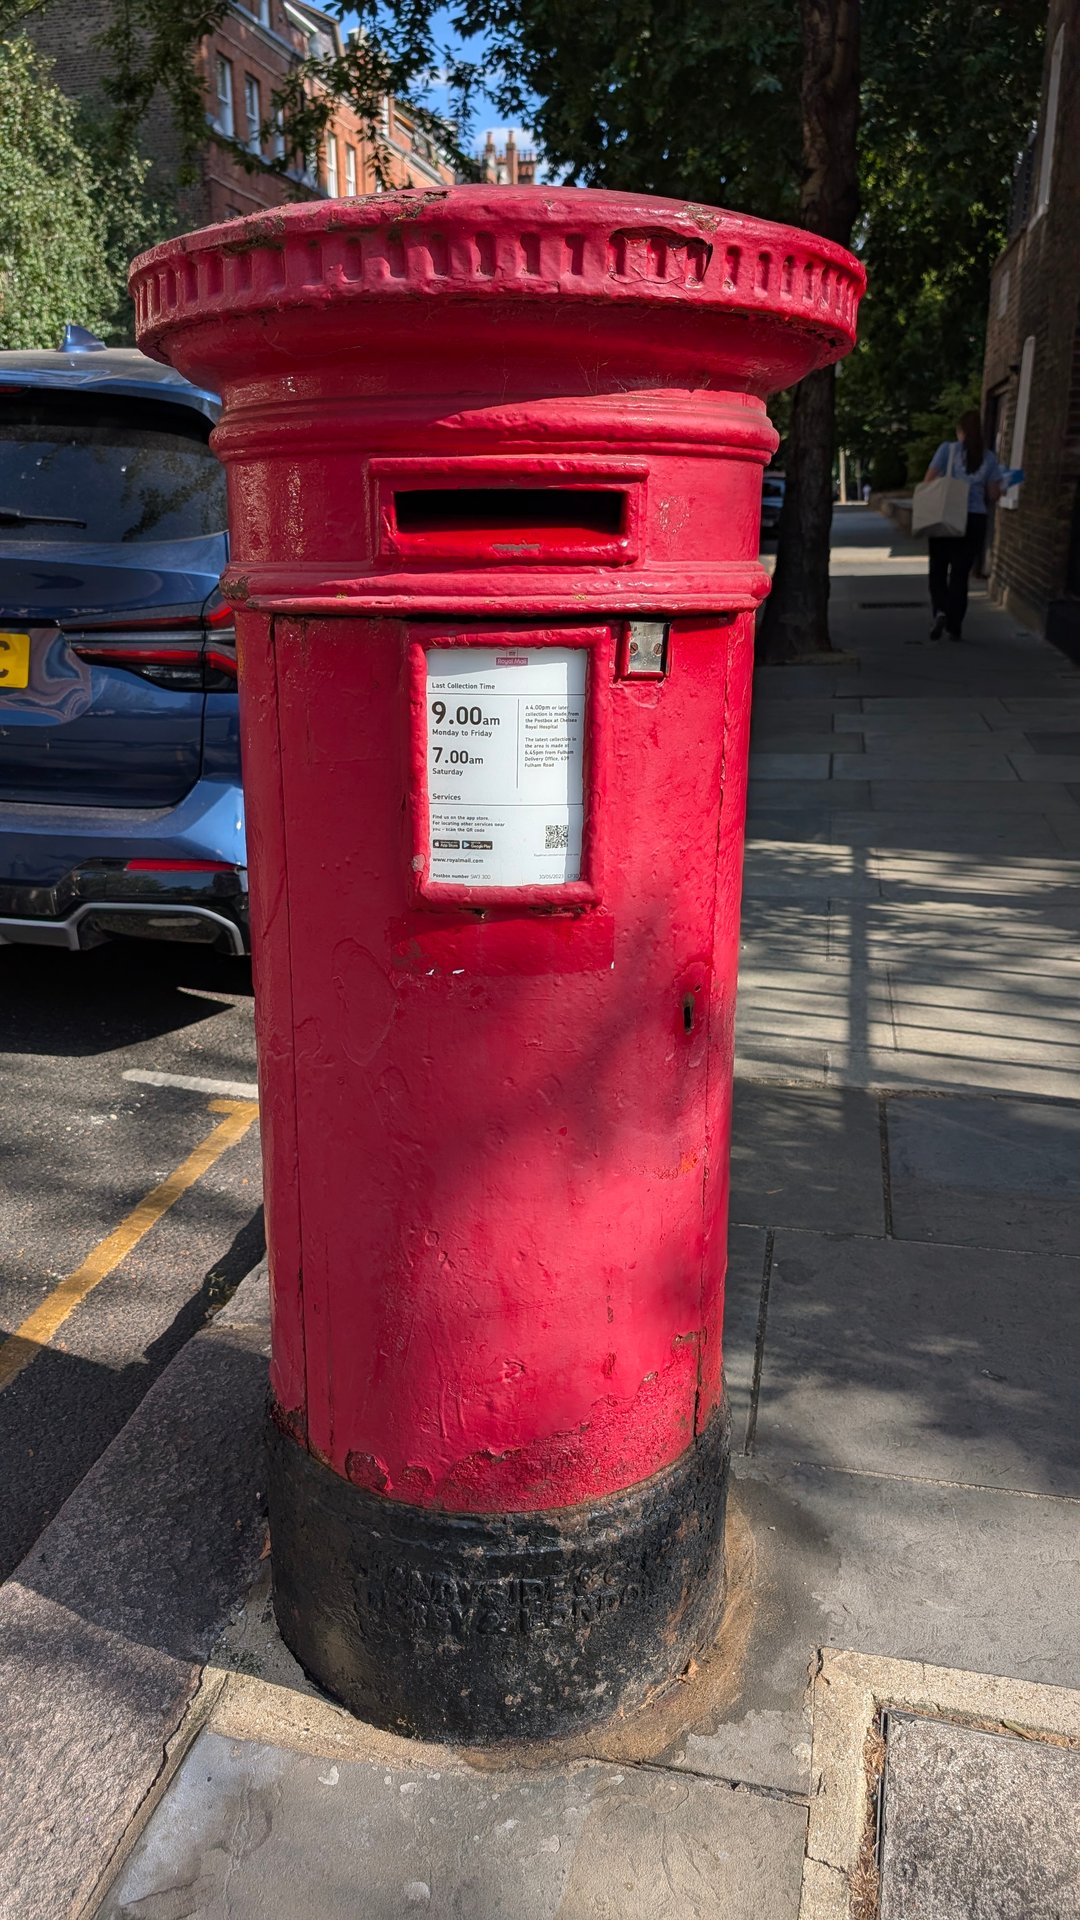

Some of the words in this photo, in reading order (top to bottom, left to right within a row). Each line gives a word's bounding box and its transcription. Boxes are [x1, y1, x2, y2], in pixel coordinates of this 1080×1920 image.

[497, 658, 514, 666] Royal
[432, 701, 500, 726] 9.00am
[432, 729, 459, 737] Monday
[471, 730, 492, 738] Friday
[432, 747, 484, 765] 7.00am
[432, 768, 464, 777] Saturday
[432, 793, 462, 801] Services
